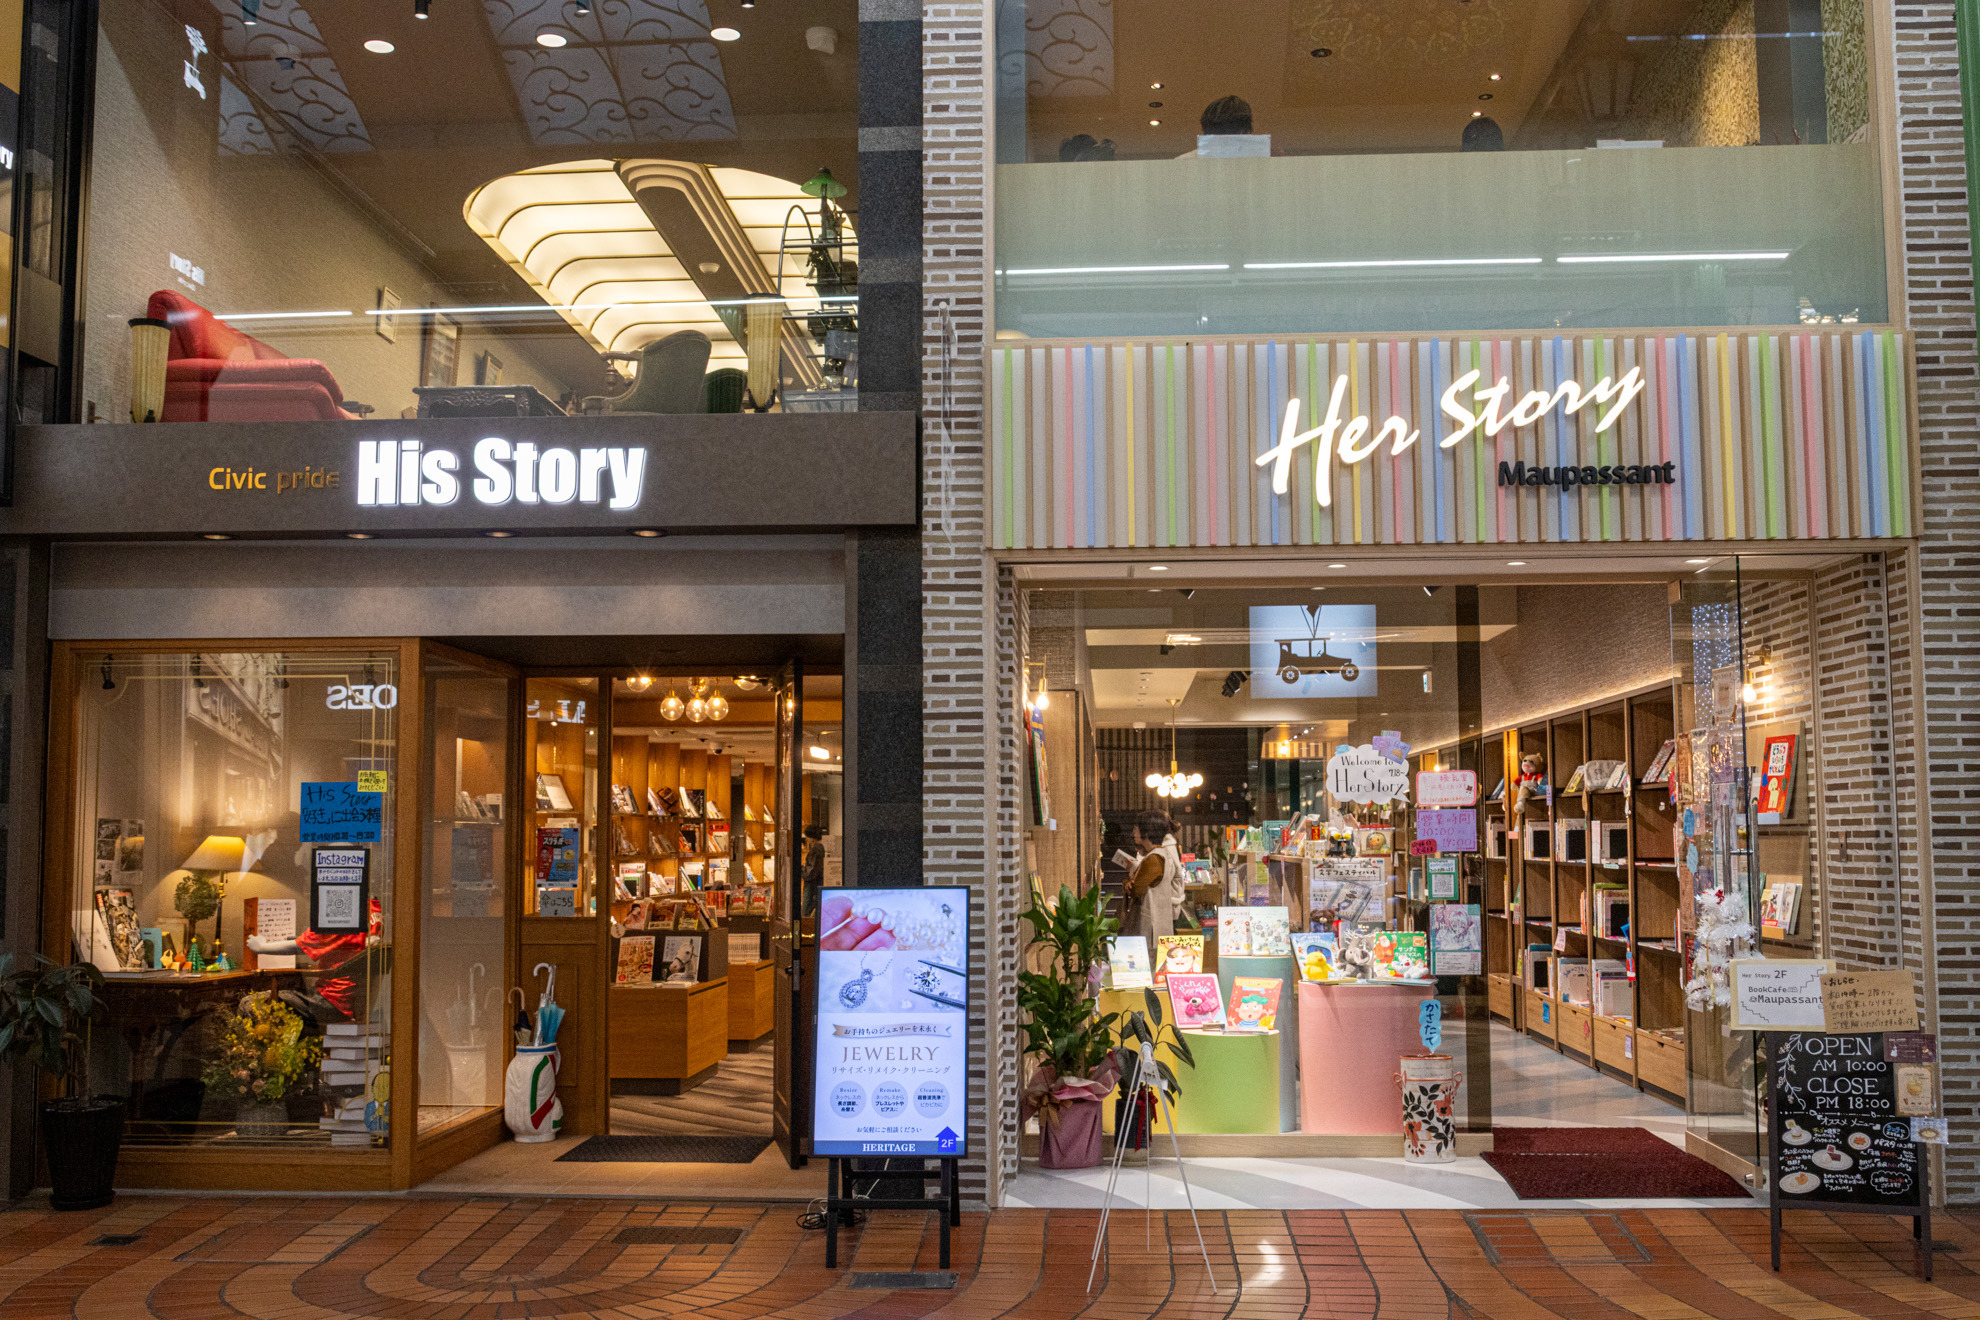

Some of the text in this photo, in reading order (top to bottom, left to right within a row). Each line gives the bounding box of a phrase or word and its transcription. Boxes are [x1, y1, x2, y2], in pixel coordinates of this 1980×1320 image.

[1255, 366, 1645, 507] Her Story
[208, 466, 339, 494] Civic pride
[357, 437, 646, 509] His Story
[1498, 460, 1676, 492] Maupassant
[1341, 755, 1382, 766] Welcome
[317, 852, 364, 865] Instagram
[1774, 970, 1787, 979] 2F
[1757, 995, 1823, 1005] Maupassant
[844, 1025, 937, 1036] お手持ちのジュエリーを末永く
[1424, 1003, 1439, 1046] かさたて
[1805, 1037, 1872, 1056] OPEN
[842, 1046, 940, 1063] JEWELRY
[1812, 1059, 1887, 1072] AM 10:00
[1807, 1077, 1880, 1095] CLOSE
[1815, 1096, 1890, 1110] PM 18:00
[862, 1143, 916, 1152] HERITAGE
[941, 1139, 954, 1148] 2F
